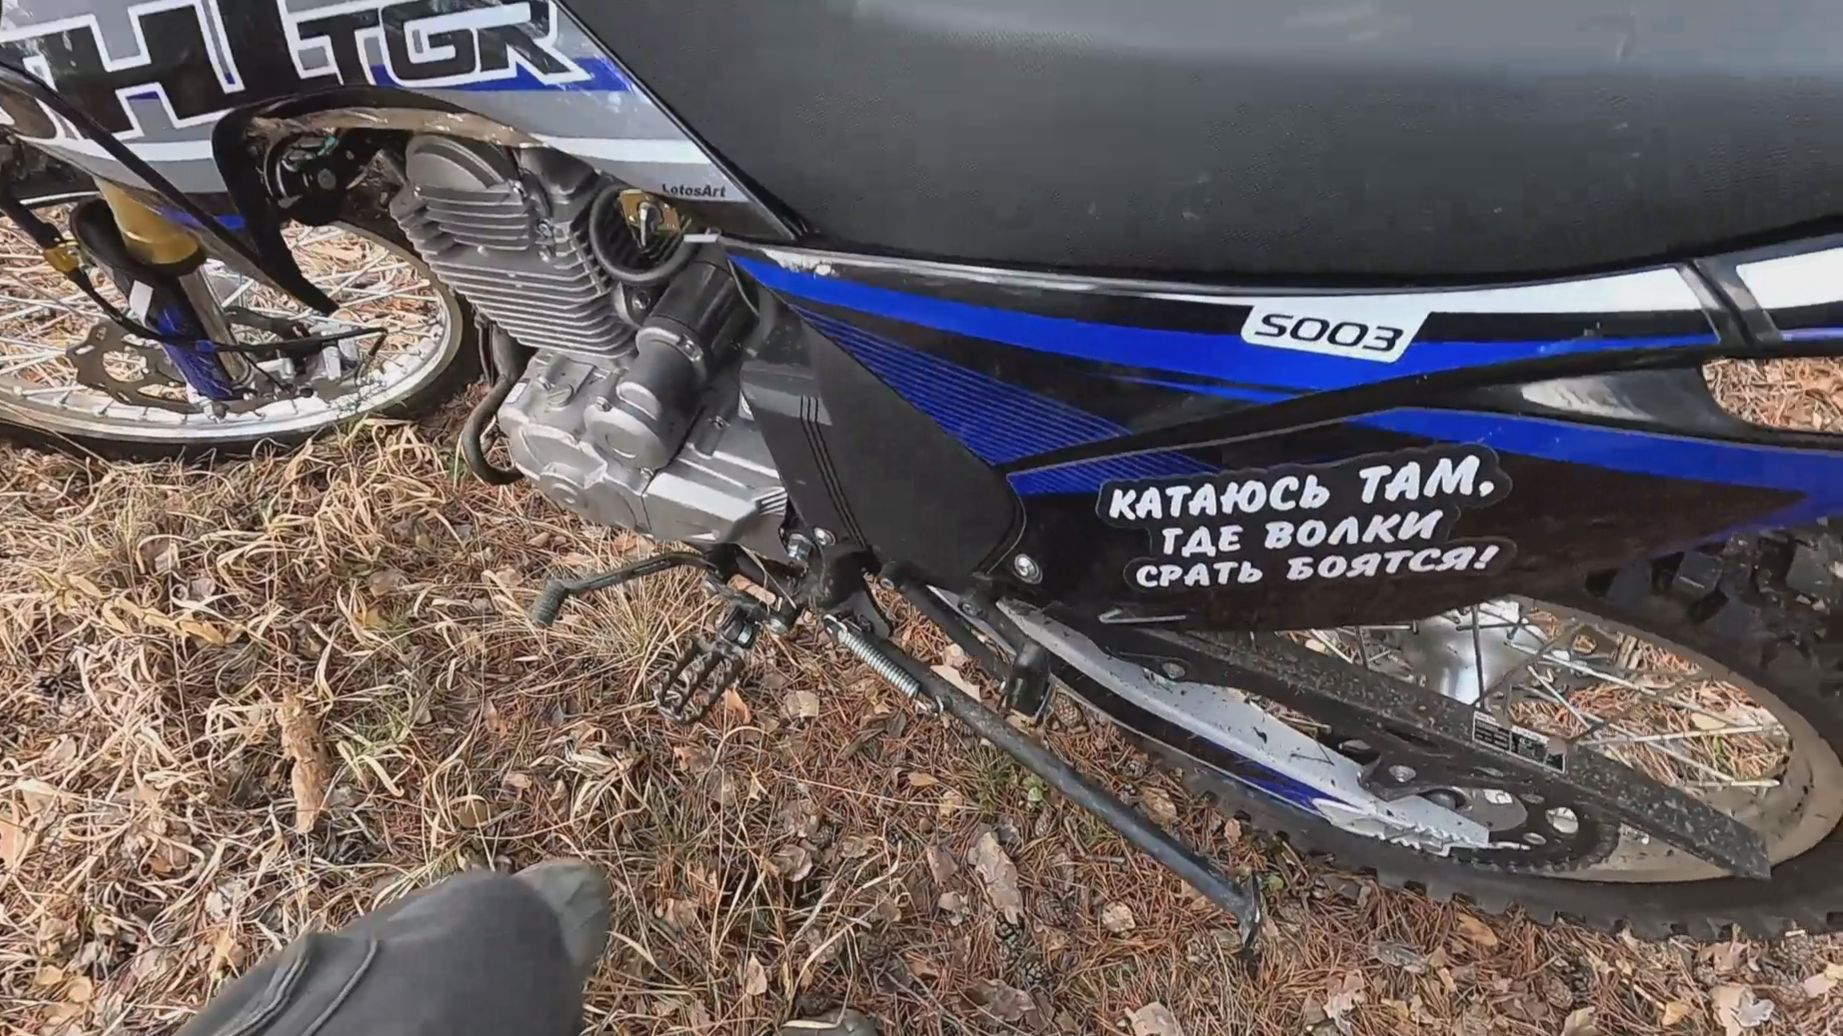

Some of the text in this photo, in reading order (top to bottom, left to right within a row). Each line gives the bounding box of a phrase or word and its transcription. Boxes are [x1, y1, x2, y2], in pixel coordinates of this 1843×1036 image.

[662, 183, 726, 198] LotosArt
[1108, 474, 1331, 520] КАТАЮСЬ
[1161, 508, 1444, 558] ГДЕ ВОЛКИ
[1135, 544, 1500, 588] СРАТЬ БОЯТСЯ!
